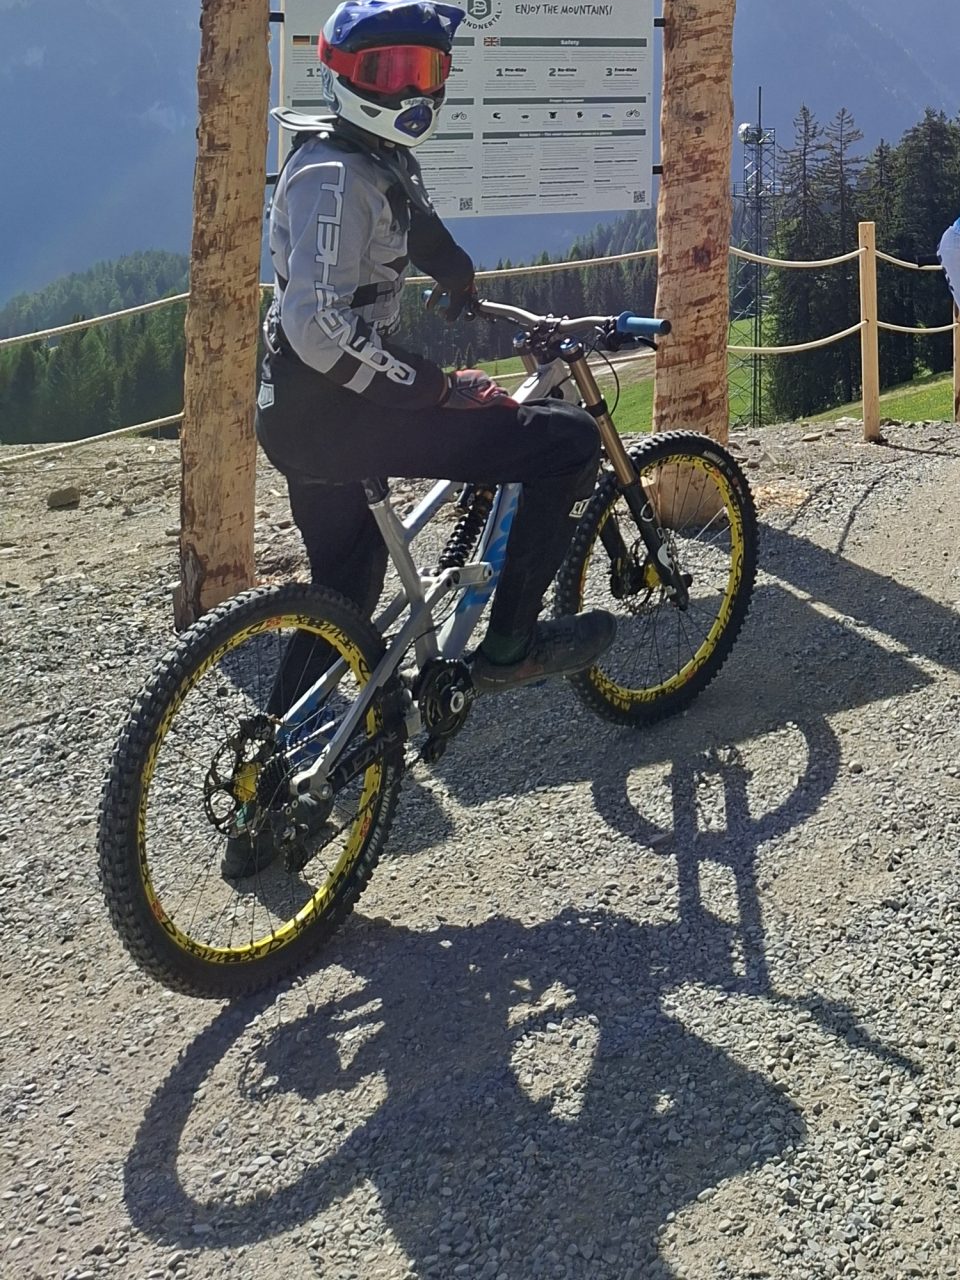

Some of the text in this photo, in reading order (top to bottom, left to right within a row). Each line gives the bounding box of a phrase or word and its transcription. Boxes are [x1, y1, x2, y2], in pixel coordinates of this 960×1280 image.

[515, 4, 612, 15] ENJOY THE MOUNTAINS!
[463, 10, 502, 30] ANDNERTAL
[496, 68, 504, 77] 1
[549, 68, 556, 77] 2
[605, 68, 613, 77] 3
